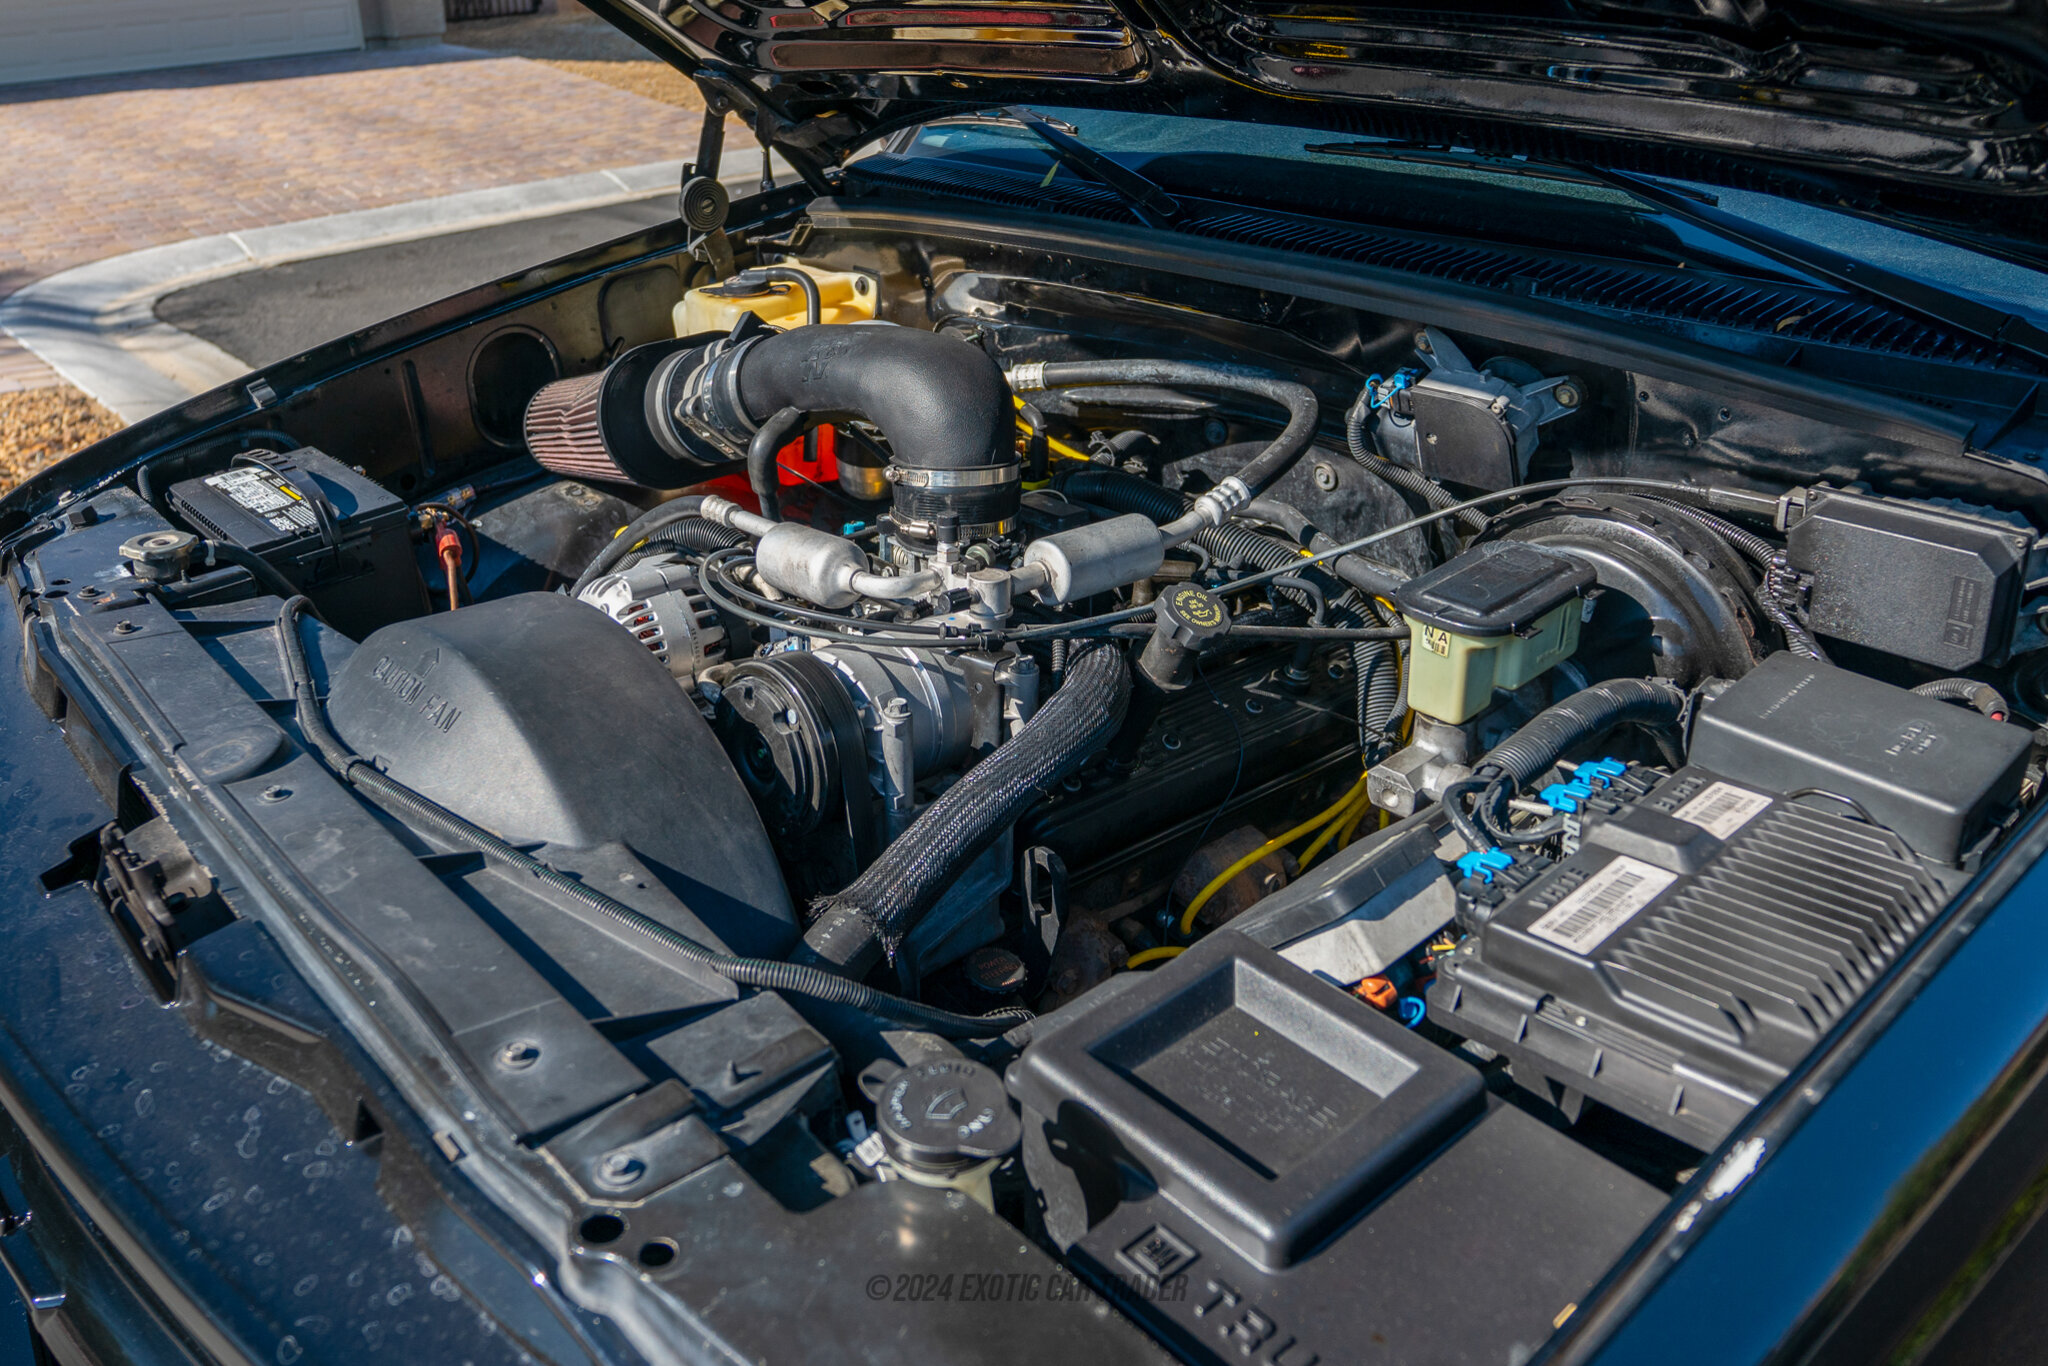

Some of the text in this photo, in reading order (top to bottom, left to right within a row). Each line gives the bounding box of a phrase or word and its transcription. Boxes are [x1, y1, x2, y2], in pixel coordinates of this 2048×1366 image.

[1175, 590, 1195, 607] ENGINE
[1196, 592, 1208, 601] OIL
[1180, 610, 1192, 621] SEE
[1438, 632, 1448, 645] A
[373, 656, 462, 733] CAUTION FAN
